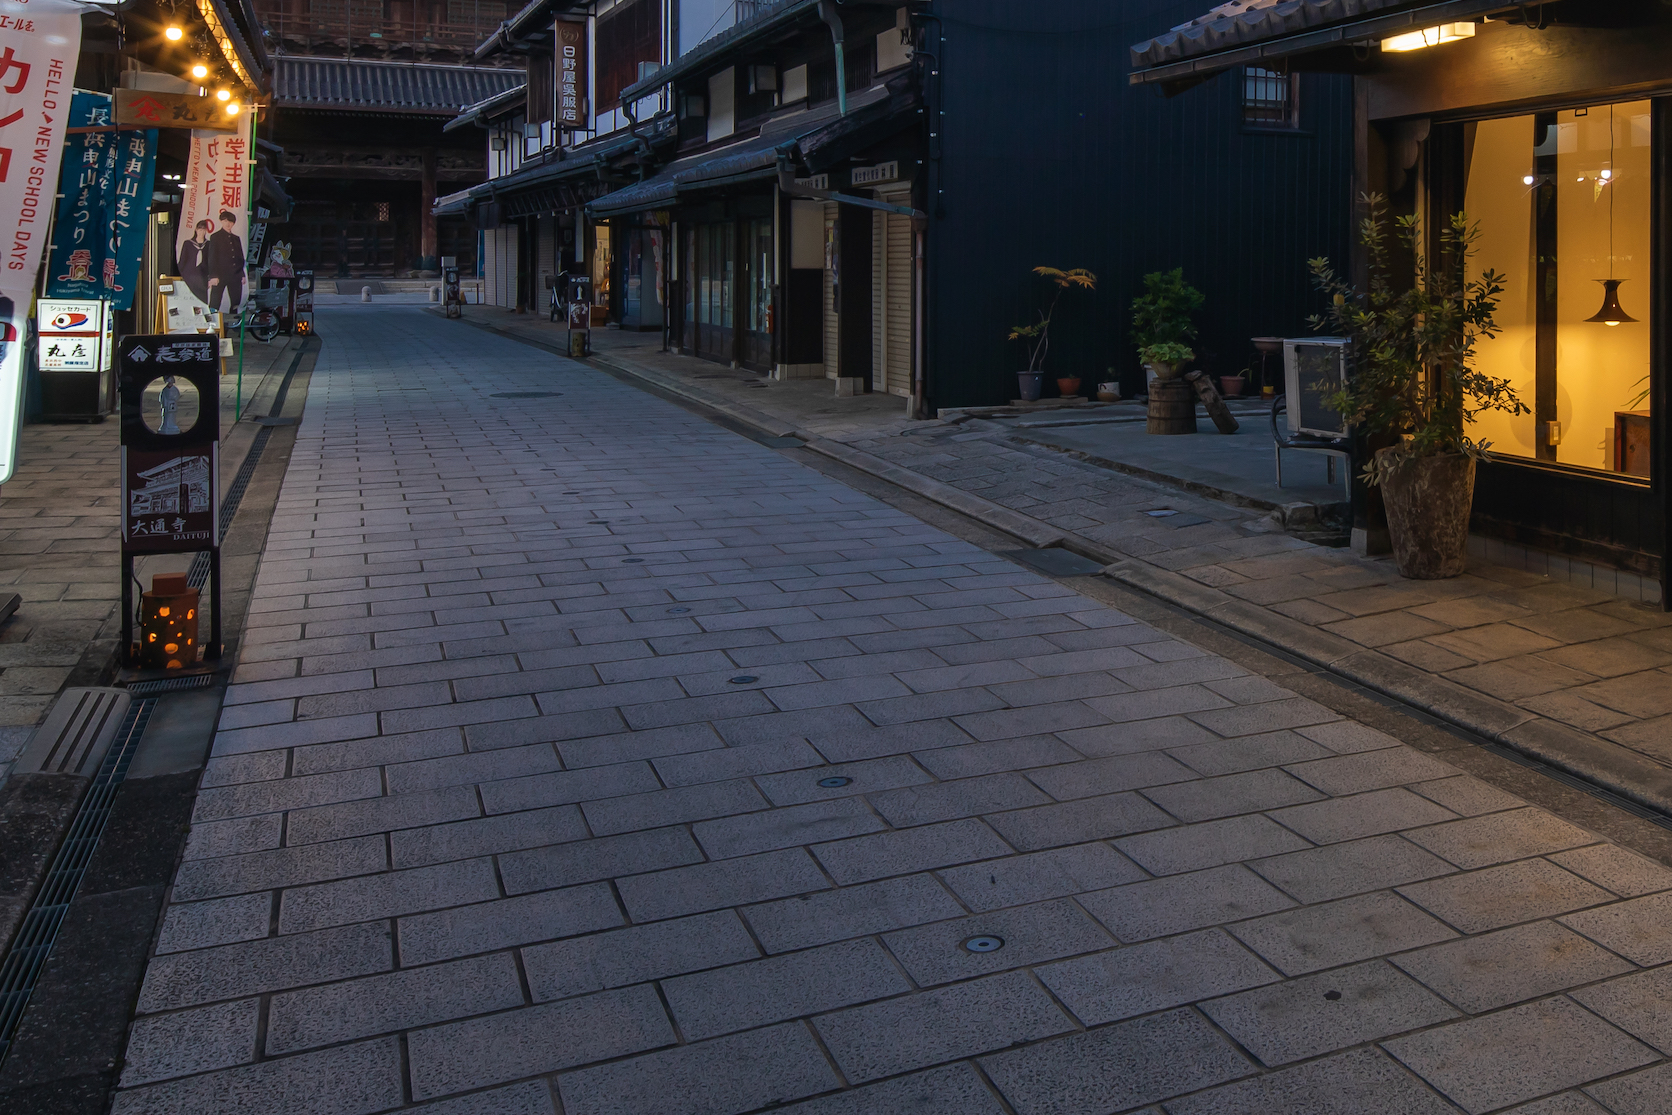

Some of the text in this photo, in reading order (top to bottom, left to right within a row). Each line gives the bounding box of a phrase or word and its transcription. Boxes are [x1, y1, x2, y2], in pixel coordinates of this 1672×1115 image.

[8, 58, 63, 271] HELLO NEW SCHOOL DAYS
[73, 107, 109, 245] 長浜曳山まつり
[155, 344, 213, 363] 表参道
[131, 517, 187, 535] 大通寺
